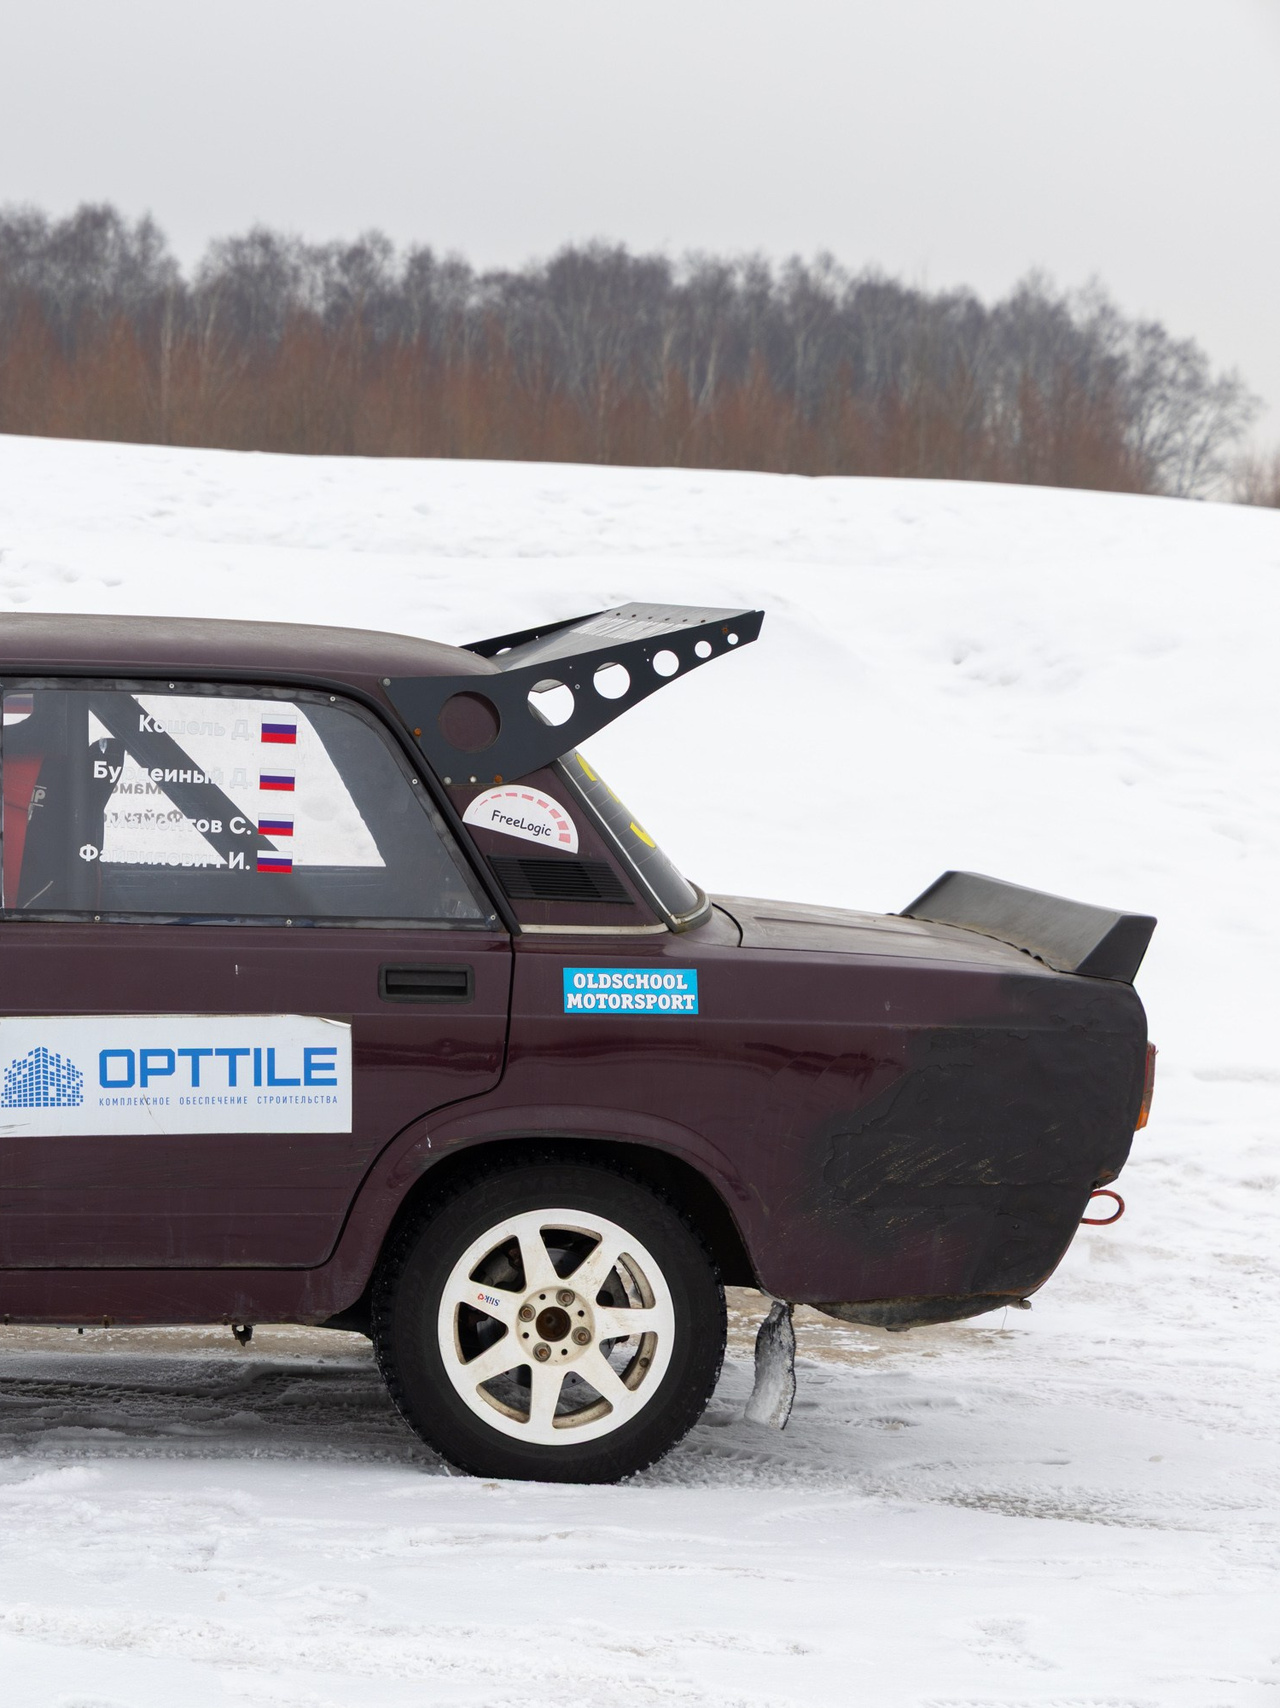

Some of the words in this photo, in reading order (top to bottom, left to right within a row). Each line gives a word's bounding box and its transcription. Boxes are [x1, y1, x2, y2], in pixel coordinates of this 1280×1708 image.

[139, 714, 225, 736] Кошель
[229, 816, 252, 835] С.
[491, 809, 551, 837] FreeLogic
[228, 851, 251, 870] И.
[573, 973, 688, 990] OLDSCHOOL
[566, 994, 695, 1010] MOTORSPORT
[98, 1047, 338, 1089] OPTTILE
[99, 1097, 170, 1106] КОМПЛЕКСНОЕ
[179, 1096, 248, 1106] ОБЕСПЕЧЕНИЕ
[257, 1095, 338, 1105] СТРОИТЕЛЬСТВА
